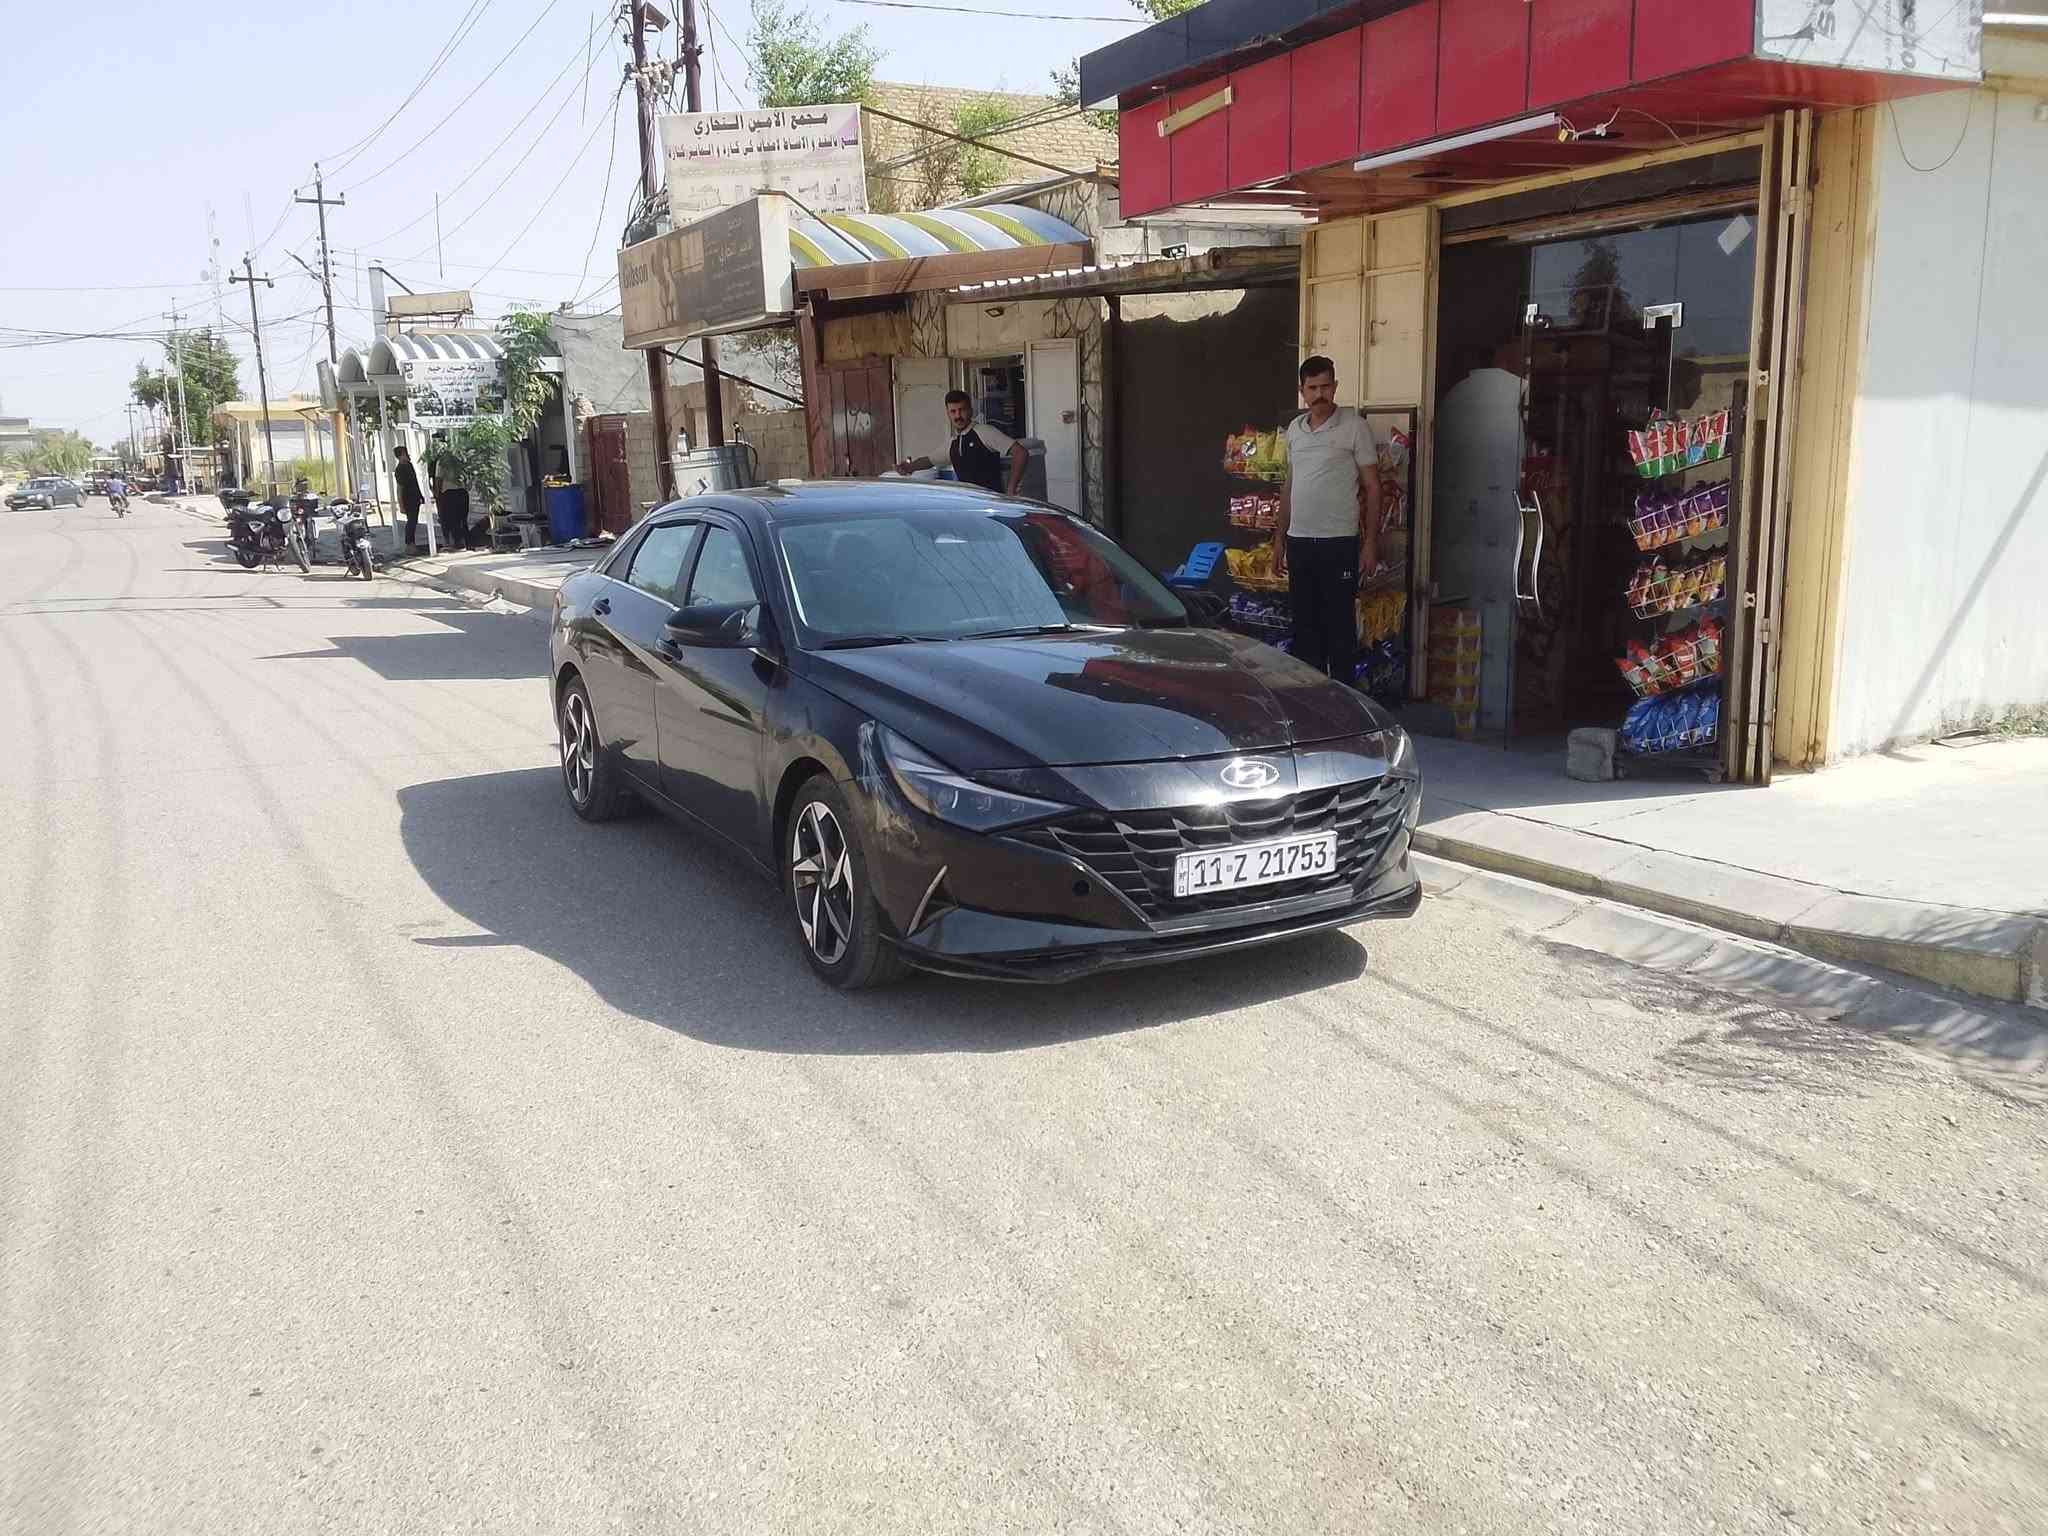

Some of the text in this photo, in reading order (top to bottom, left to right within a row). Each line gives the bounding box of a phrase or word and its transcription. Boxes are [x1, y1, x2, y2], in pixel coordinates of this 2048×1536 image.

[694, 111, 828, 139] مجمع الامين التجاري
[1193, 841, 1328, 888] 11 Z 21753
